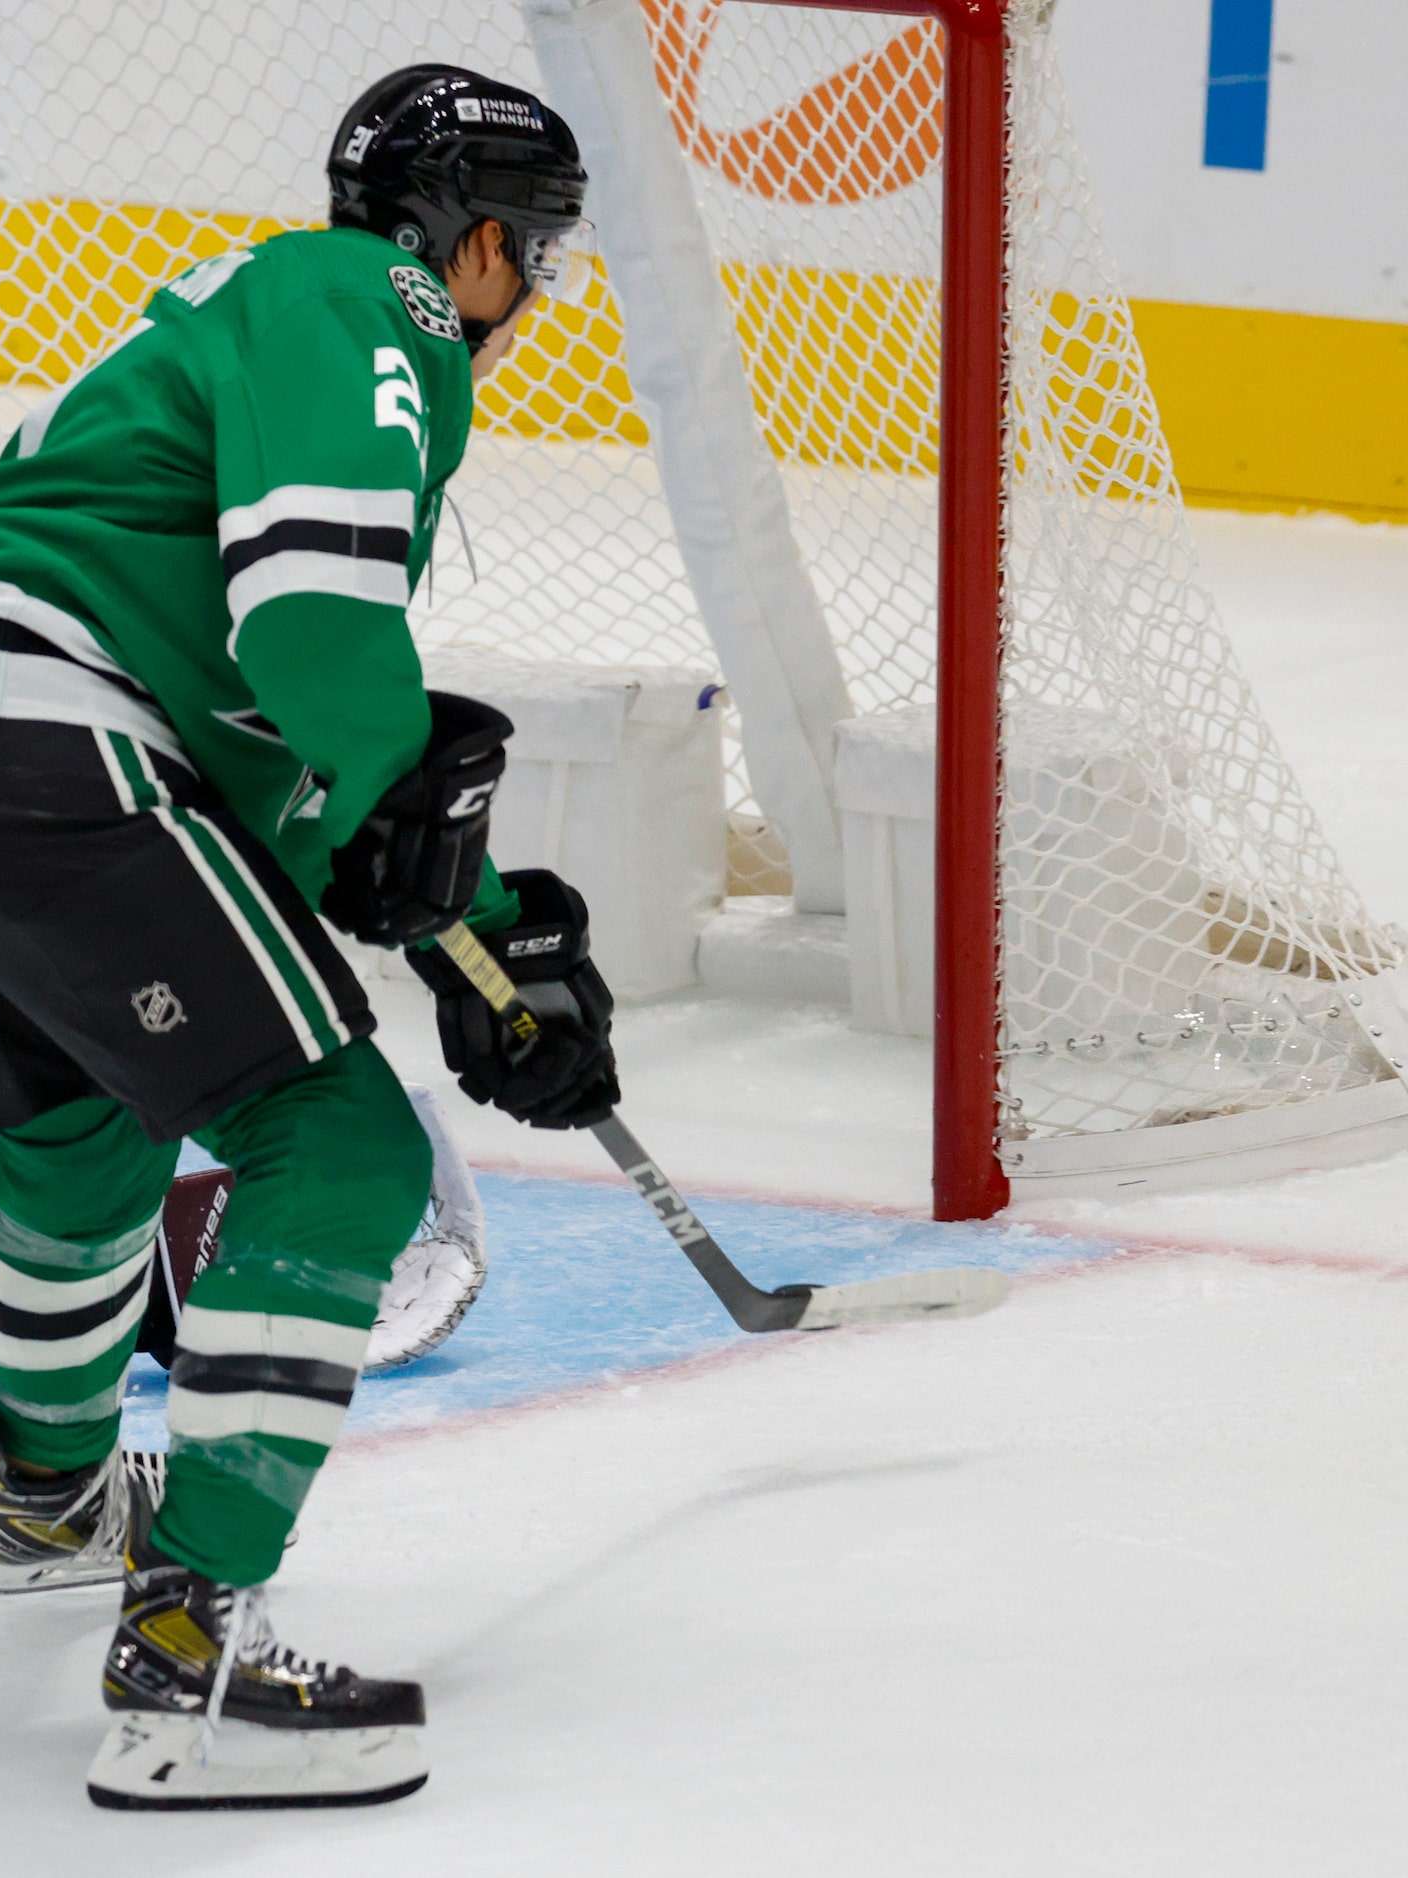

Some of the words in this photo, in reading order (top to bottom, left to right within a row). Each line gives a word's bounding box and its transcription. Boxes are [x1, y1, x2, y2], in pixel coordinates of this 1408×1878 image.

[481, 99, 530, 116] ENERGY
[485, 111, 544, 132] TRANSFER
[626, 1163, 707, 1247] CCM
